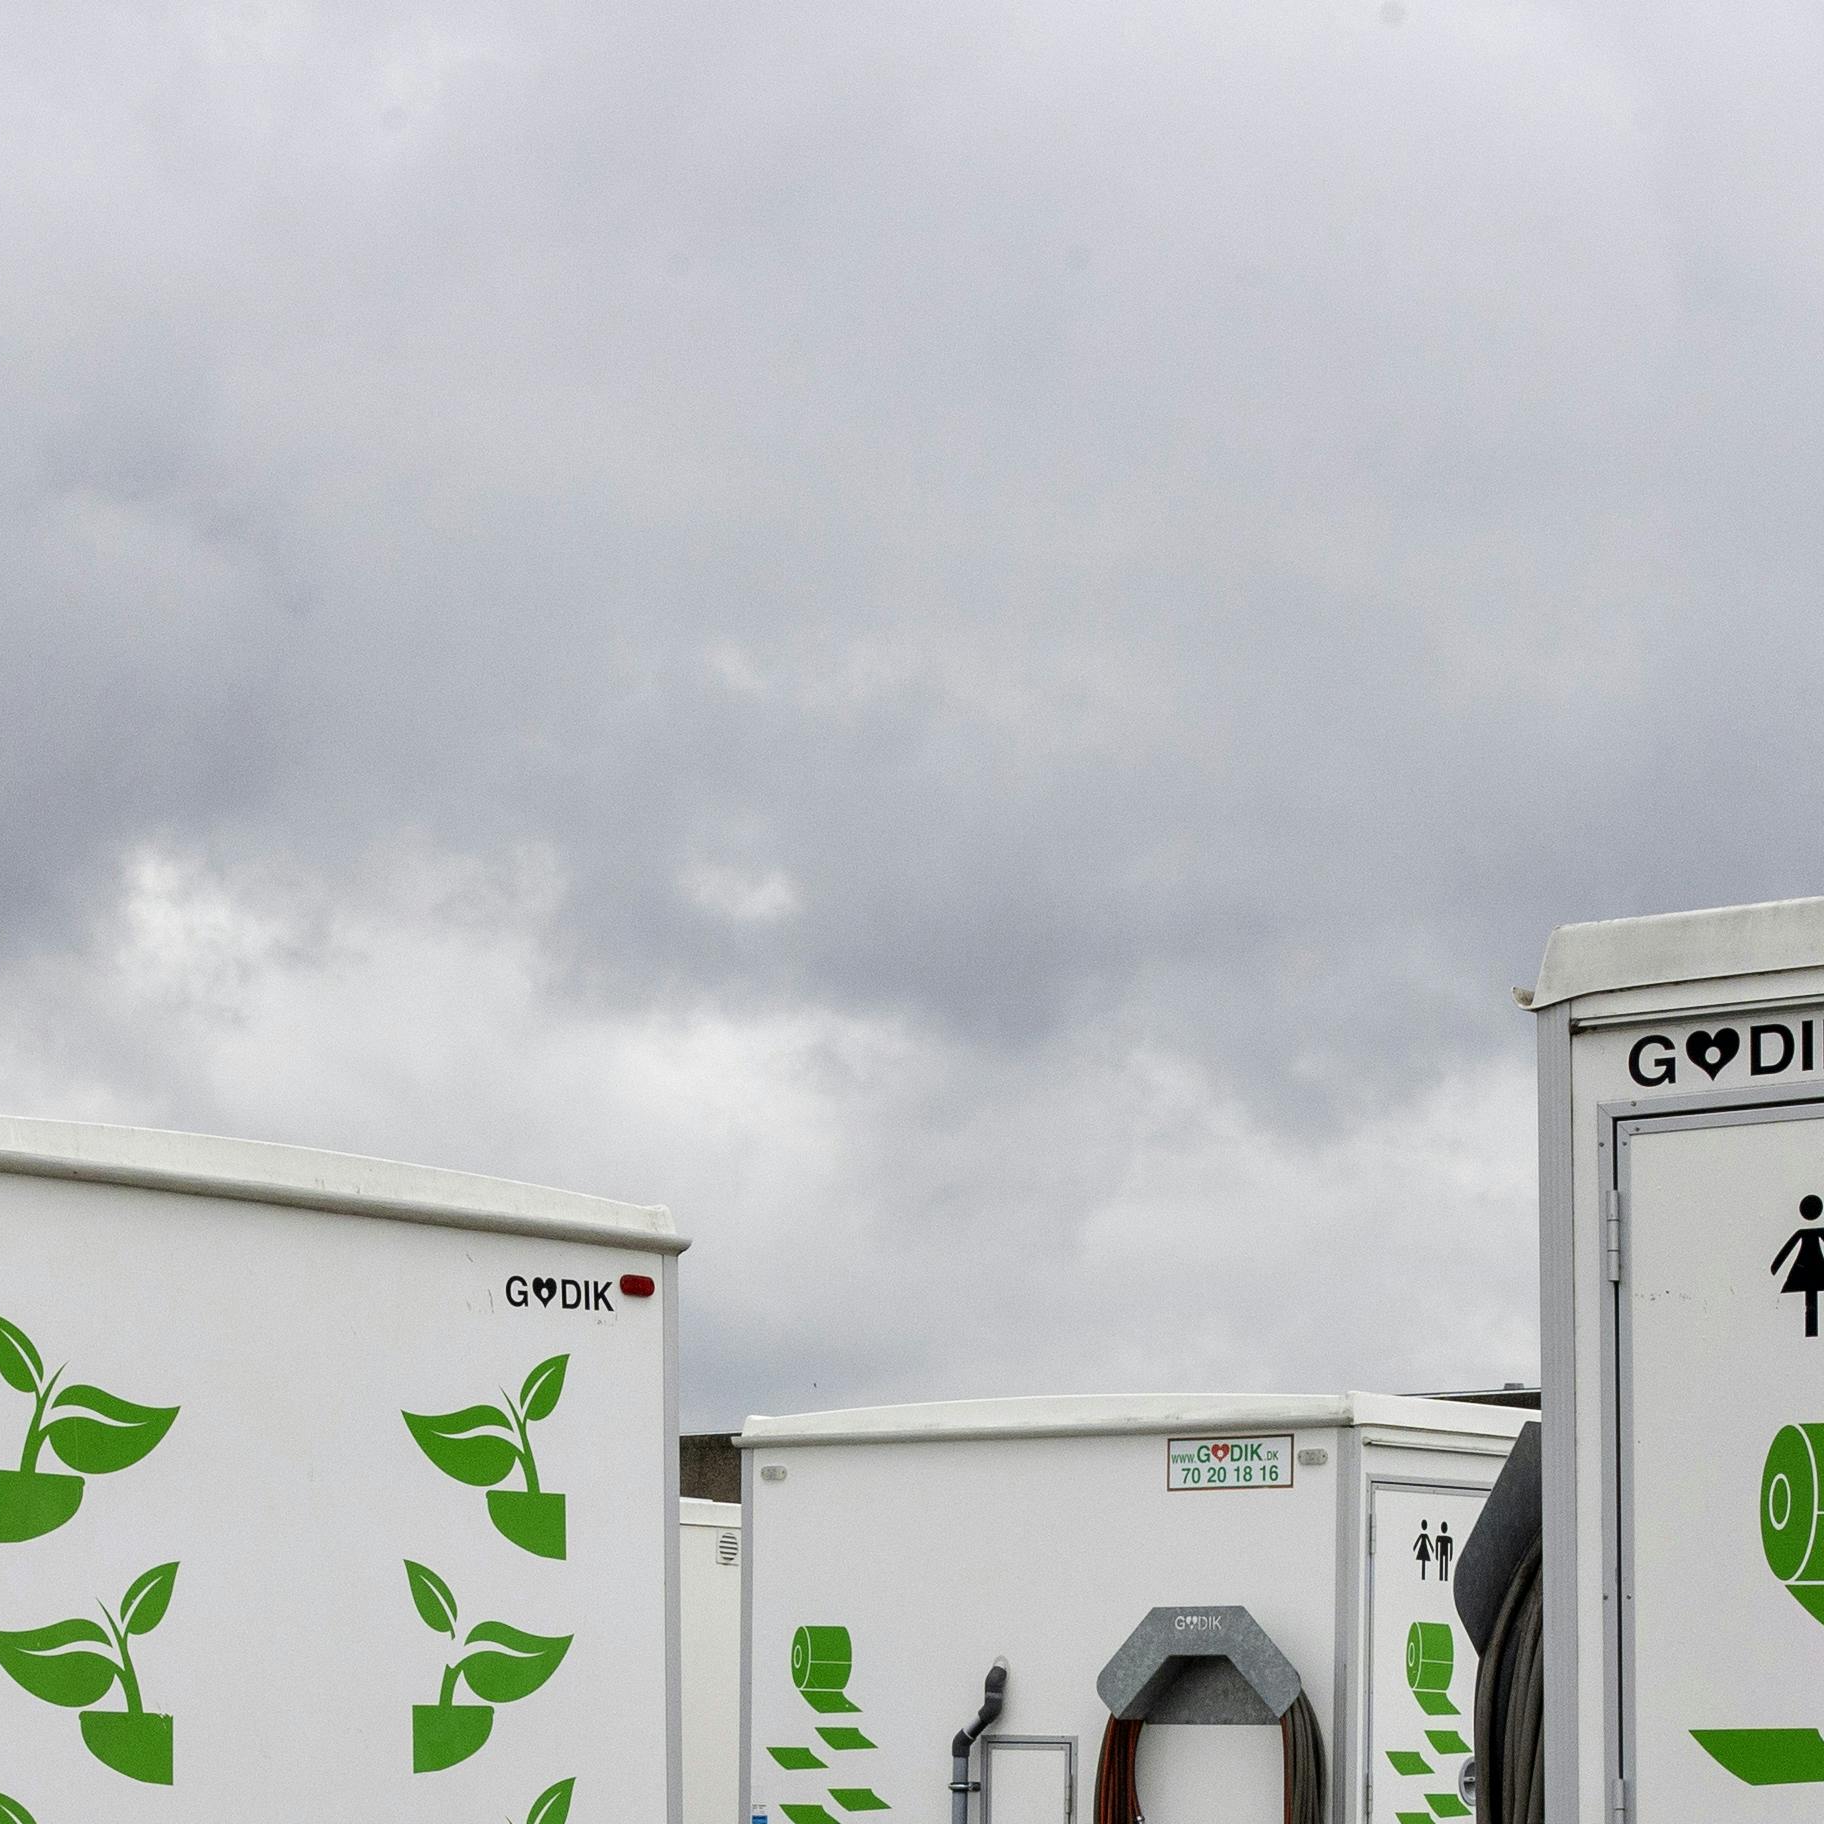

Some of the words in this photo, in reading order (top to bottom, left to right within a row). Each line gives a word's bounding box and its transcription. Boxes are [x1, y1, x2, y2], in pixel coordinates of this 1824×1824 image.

[1181, 1467, 1201, 1484] 70
[1207, 1466, 1227, 1483] 20
[1234, 1465, 1253, 1482] 18
[1260, 1464, 1279, 1481] 16
